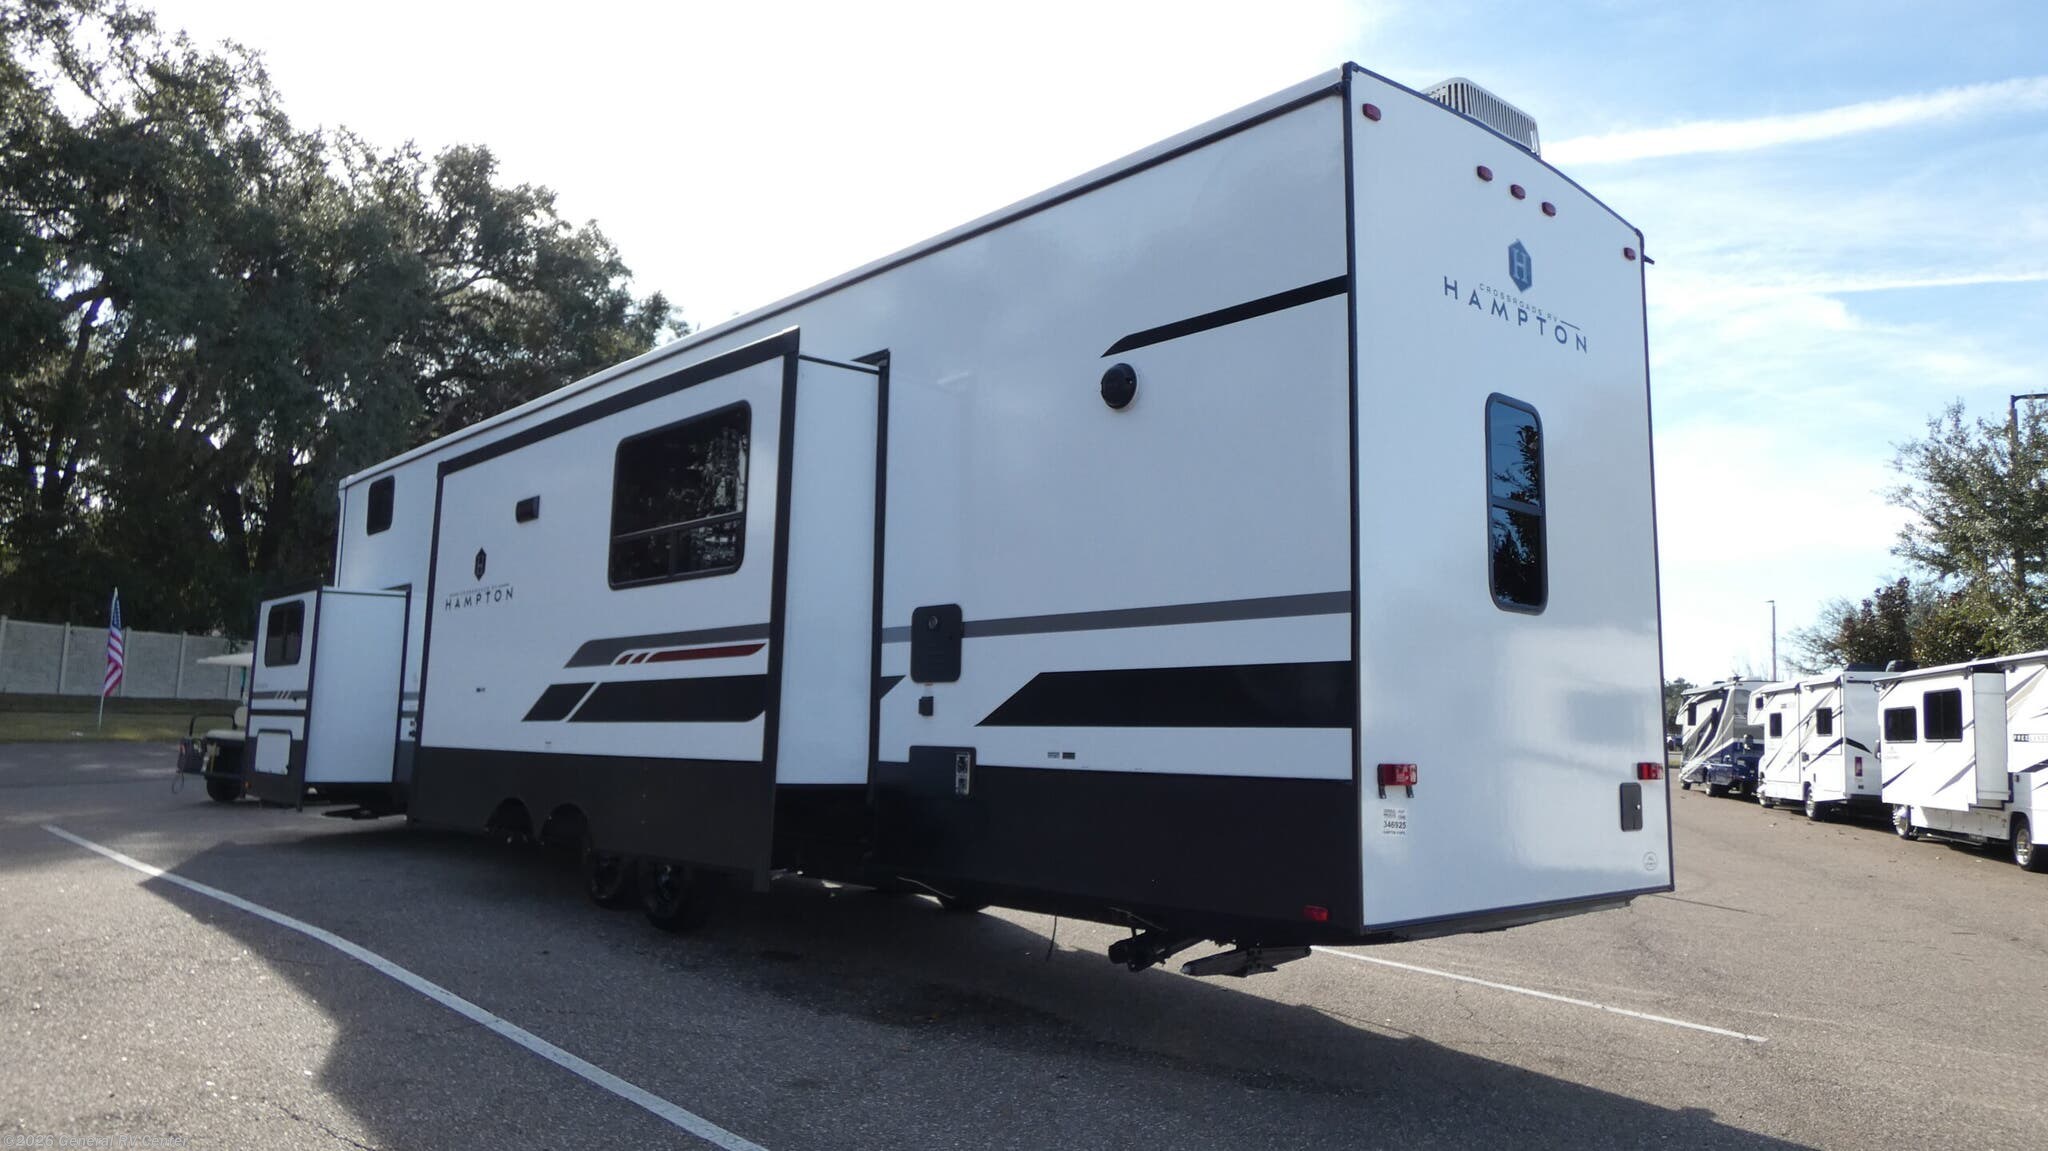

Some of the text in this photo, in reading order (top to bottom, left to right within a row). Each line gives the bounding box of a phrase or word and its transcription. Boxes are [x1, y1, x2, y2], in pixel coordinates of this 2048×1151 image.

[1443, 275, 1588, 354] HAMPTON
[1479, 283, 1543, 317] CROSSROADS
[445, 586, 514, 611] HAMPTON
